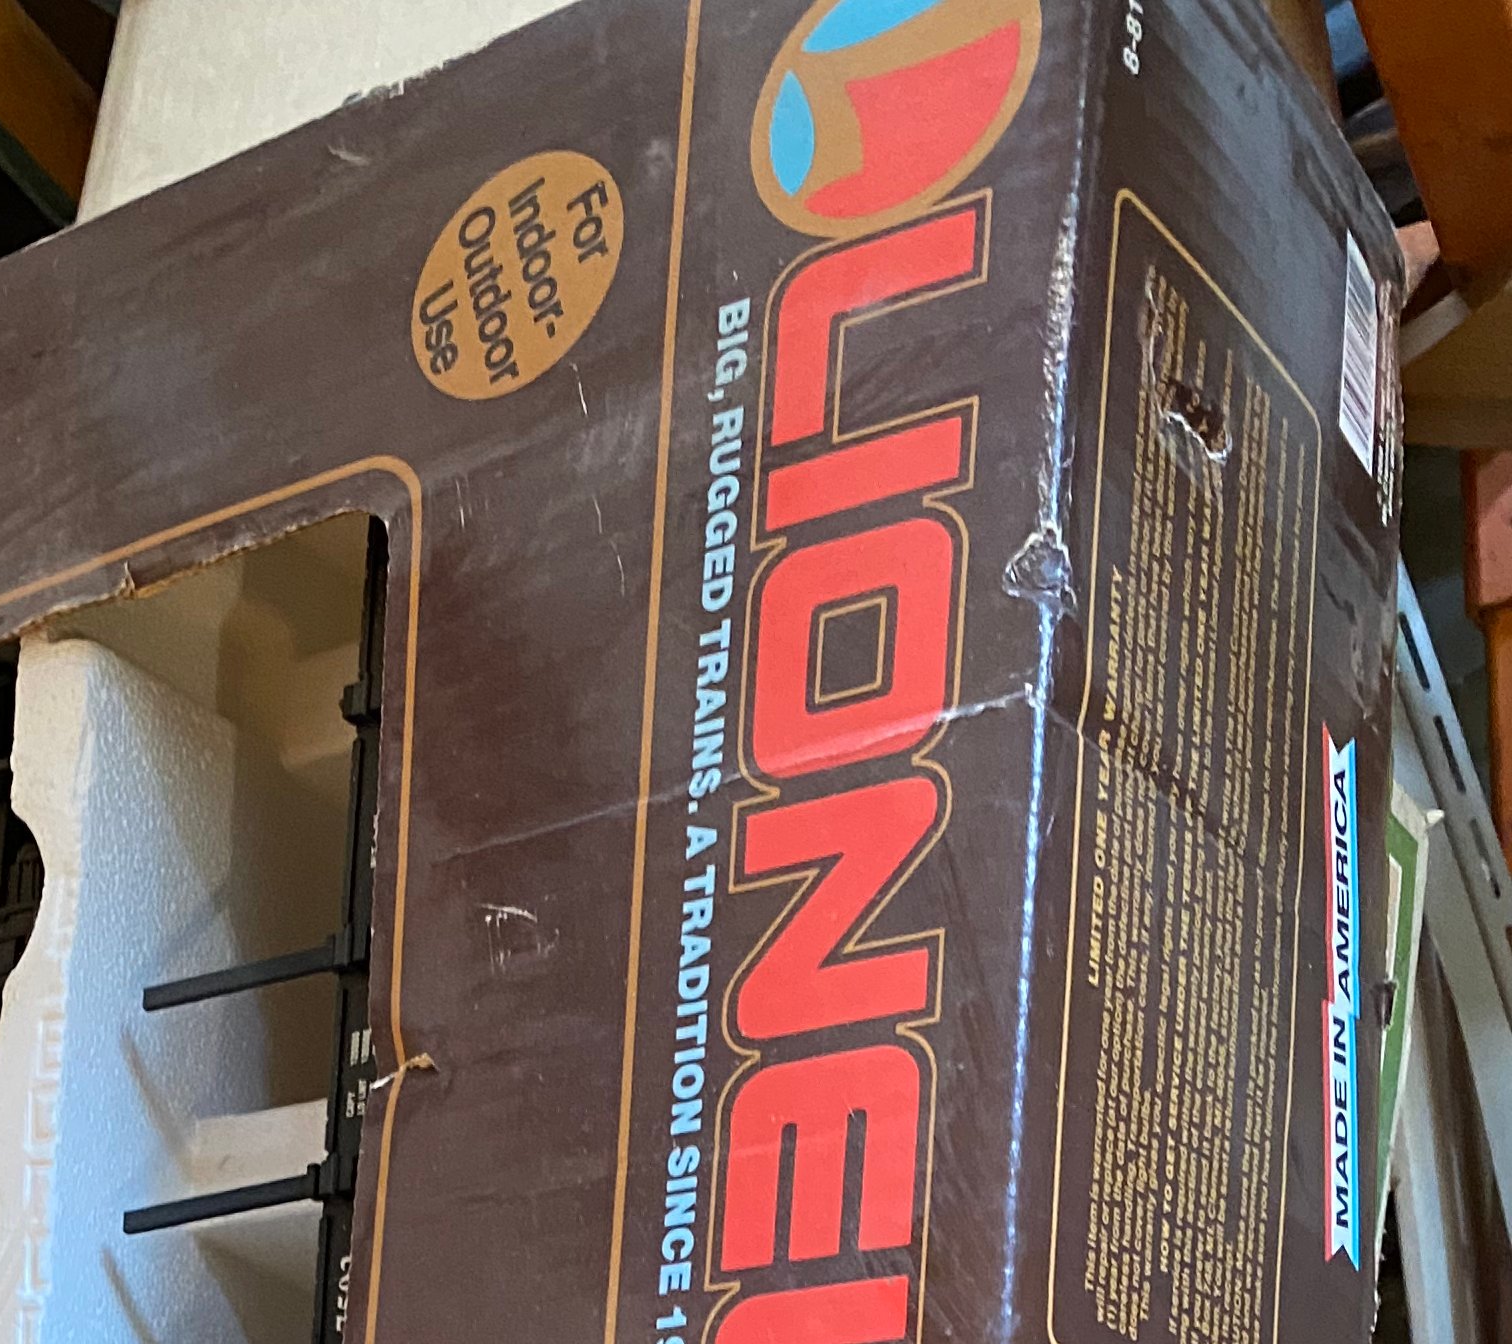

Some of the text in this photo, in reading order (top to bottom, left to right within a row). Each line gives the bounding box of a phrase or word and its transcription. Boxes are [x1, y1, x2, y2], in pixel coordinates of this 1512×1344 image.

[458, 206, 520, 385] Outdoor
[508, 176, 564, 338] Indoor-
[566, 180, 609, 263] For
[419, 278, 458, 375] Use
[708, 299, 750, 401] BIG,
[702, 408, 743, 610] RUGGED
[689, 620, 730, 812] TRAINS.
[1089, 565, 1122, 986] LIMITED ONE YEAR WARRANTY
[686, 826, 717, 859] A
[671, 866, 714, 1134] TRADITION
[1329, 769, 1353, 1230] MADE IN AMERICA
[659, 1147, 699, 1294] SINCE
